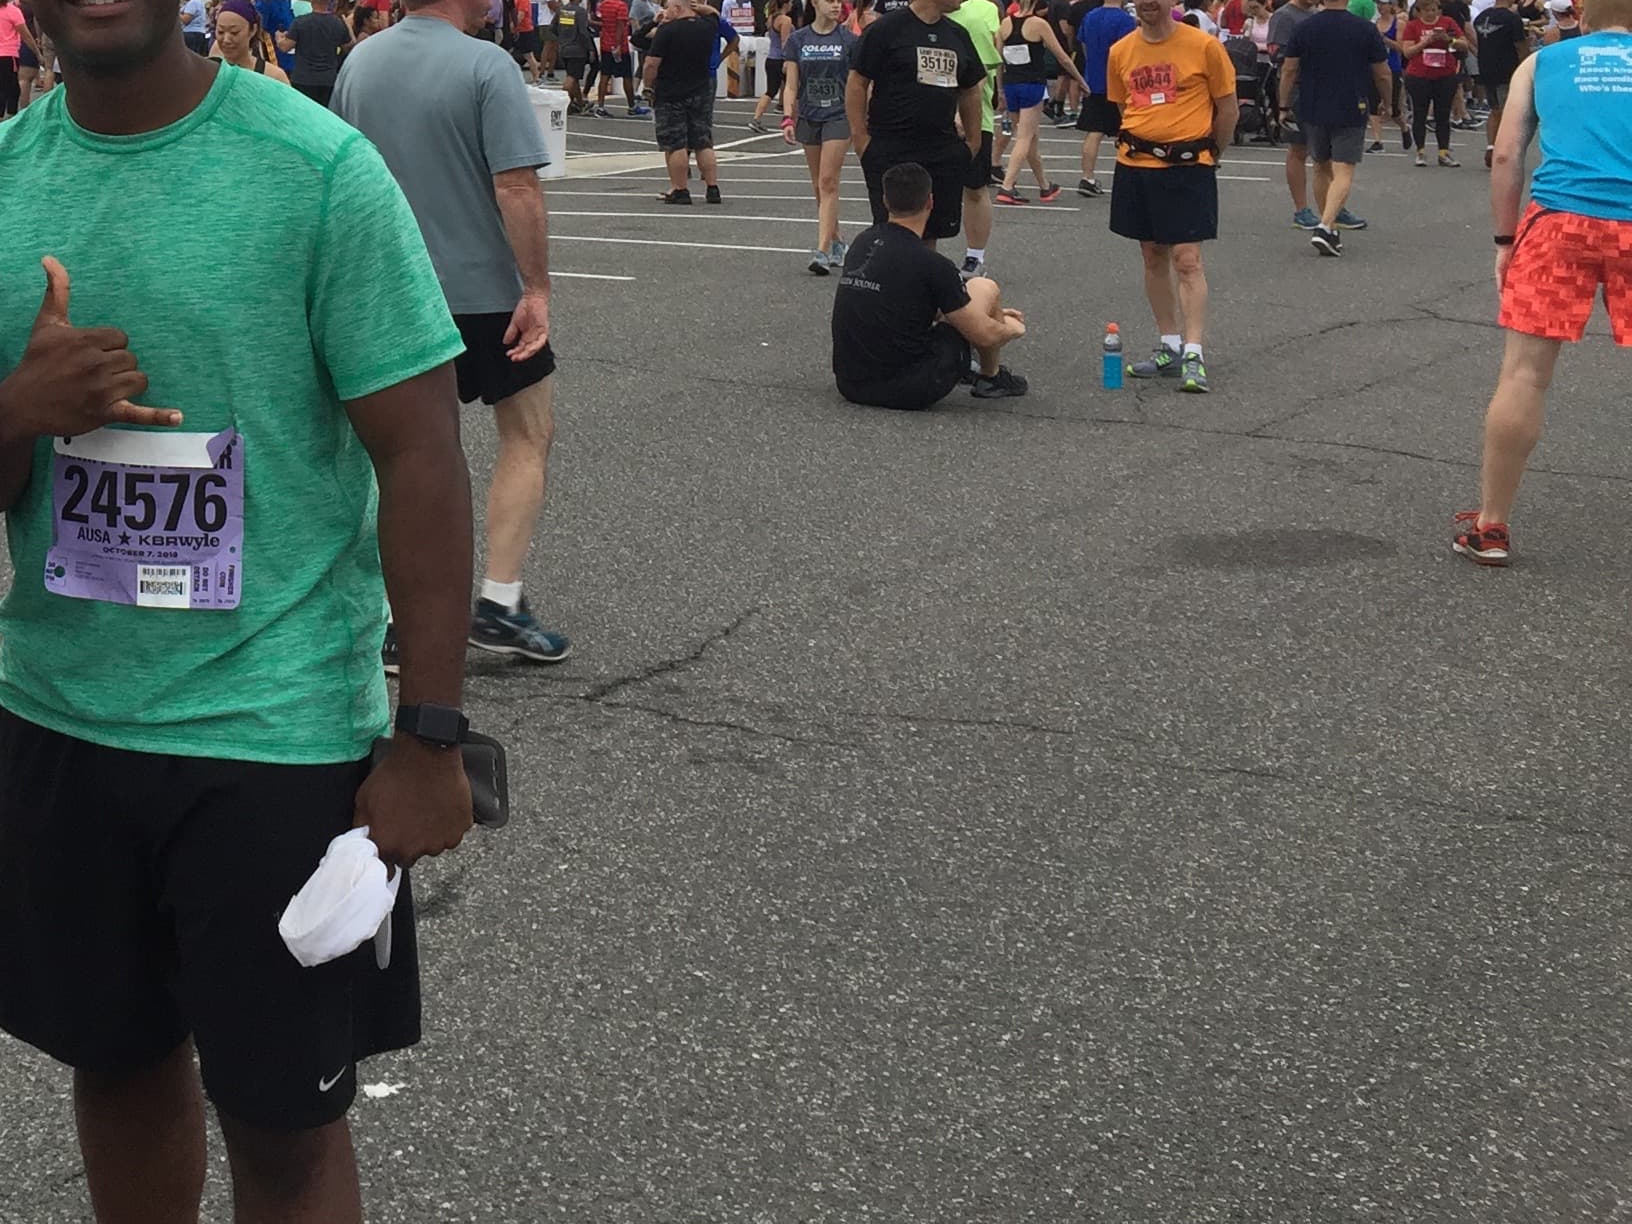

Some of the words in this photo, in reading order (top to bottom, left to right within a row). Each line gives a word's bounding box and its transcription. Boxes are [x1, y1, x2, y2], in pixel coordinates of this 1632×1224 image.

[801, 44, 843, 52] COLGAN
[920, 56, 956, 73] 35119
[61, 464, 227, 532] 24576
[77, 527, 111, 544] AUSA
[138, 533, 220, 551] KBRwyle
[103, 547, 145, 557] OCTOBER
